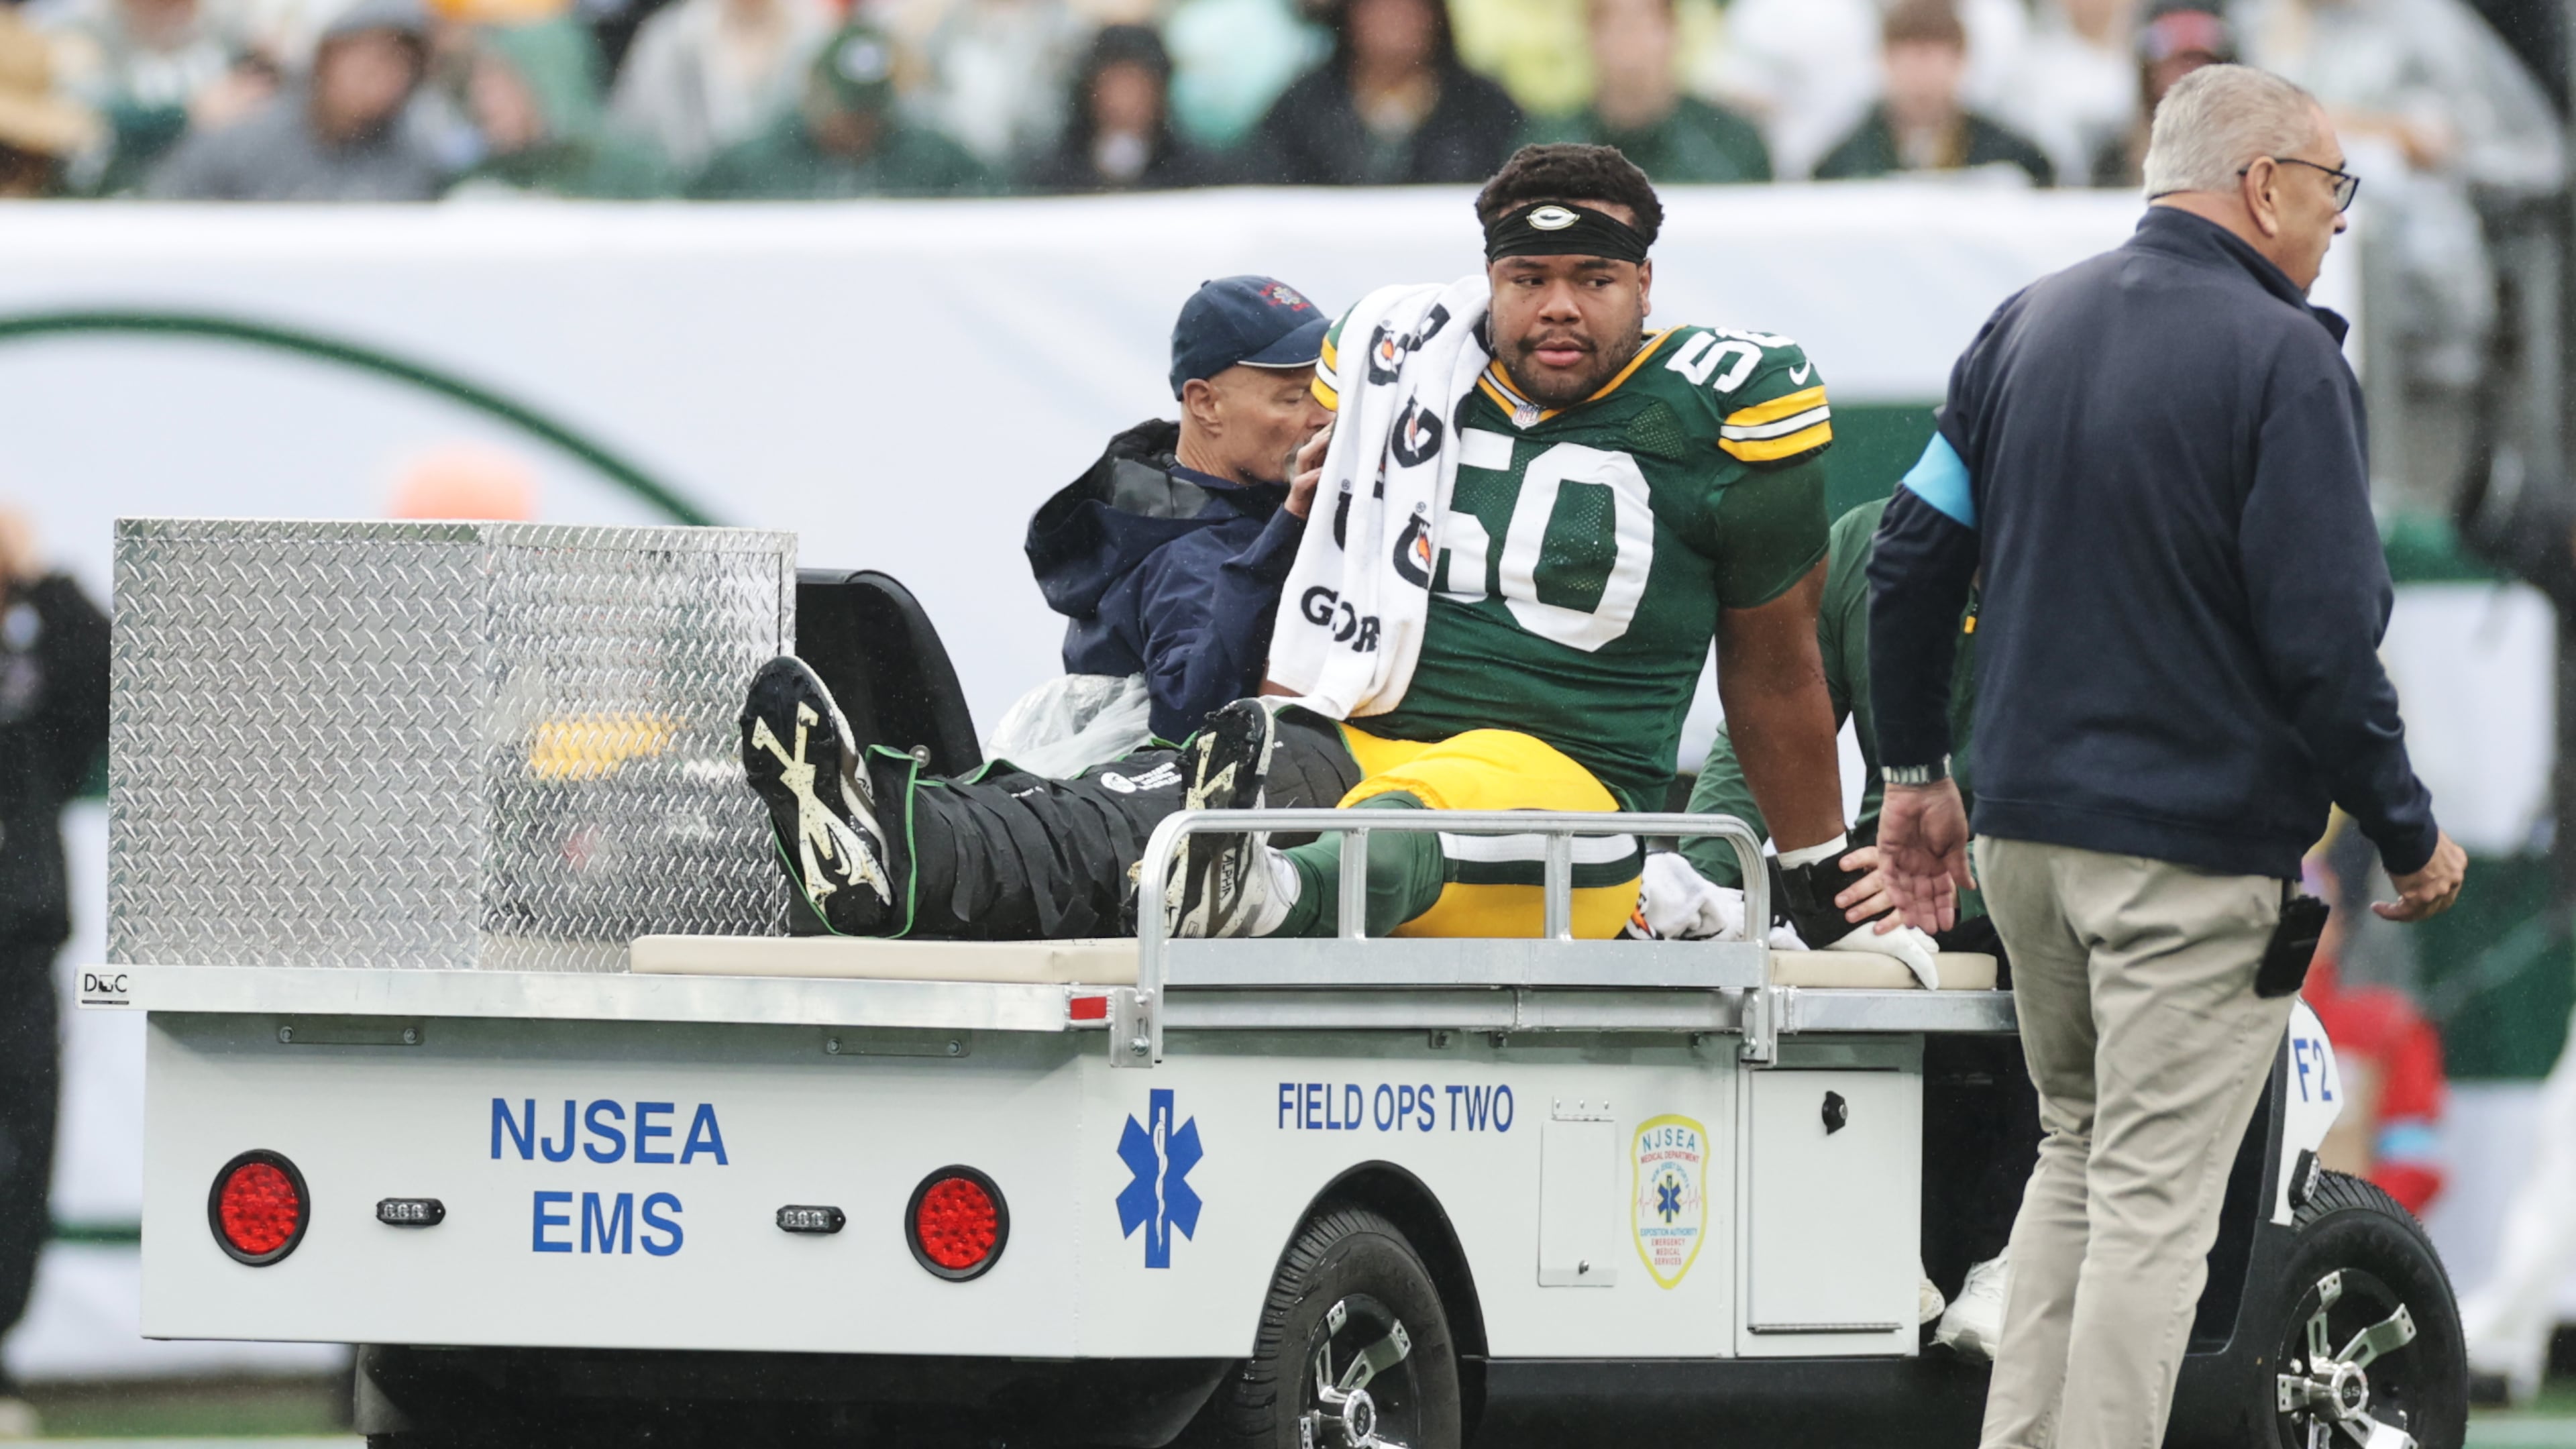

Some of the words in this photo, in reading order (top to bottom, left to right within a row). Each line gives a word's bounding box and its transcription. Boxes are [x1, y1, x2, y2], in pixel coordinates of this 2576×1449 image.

[1432, 427, 1654, 653] 50
[1220, 853, 1236, 901] ALPHA
[2292, 1038, 2333, 1102] F2
[490, 1097, 729, 1165] NJSEA
[1279, 1083, 1364, 1130] FIELD
[1374, 1083, 1436, 1132] OPS
[1445, 1083, 1514, 1133] TWO
[1641, 1151, 1664, 1164] MEDICAL
[1664, 1150, 1700, 1163] DEPARTMENT
[1642, 1128, 1696, 1153] NJSEA
[532, 1191, 684, 1256] EMS
[1640, 1228, 1668, 1236] EXPOSITION
[1670, 1228, 1697, 1236] AUTHORITY
